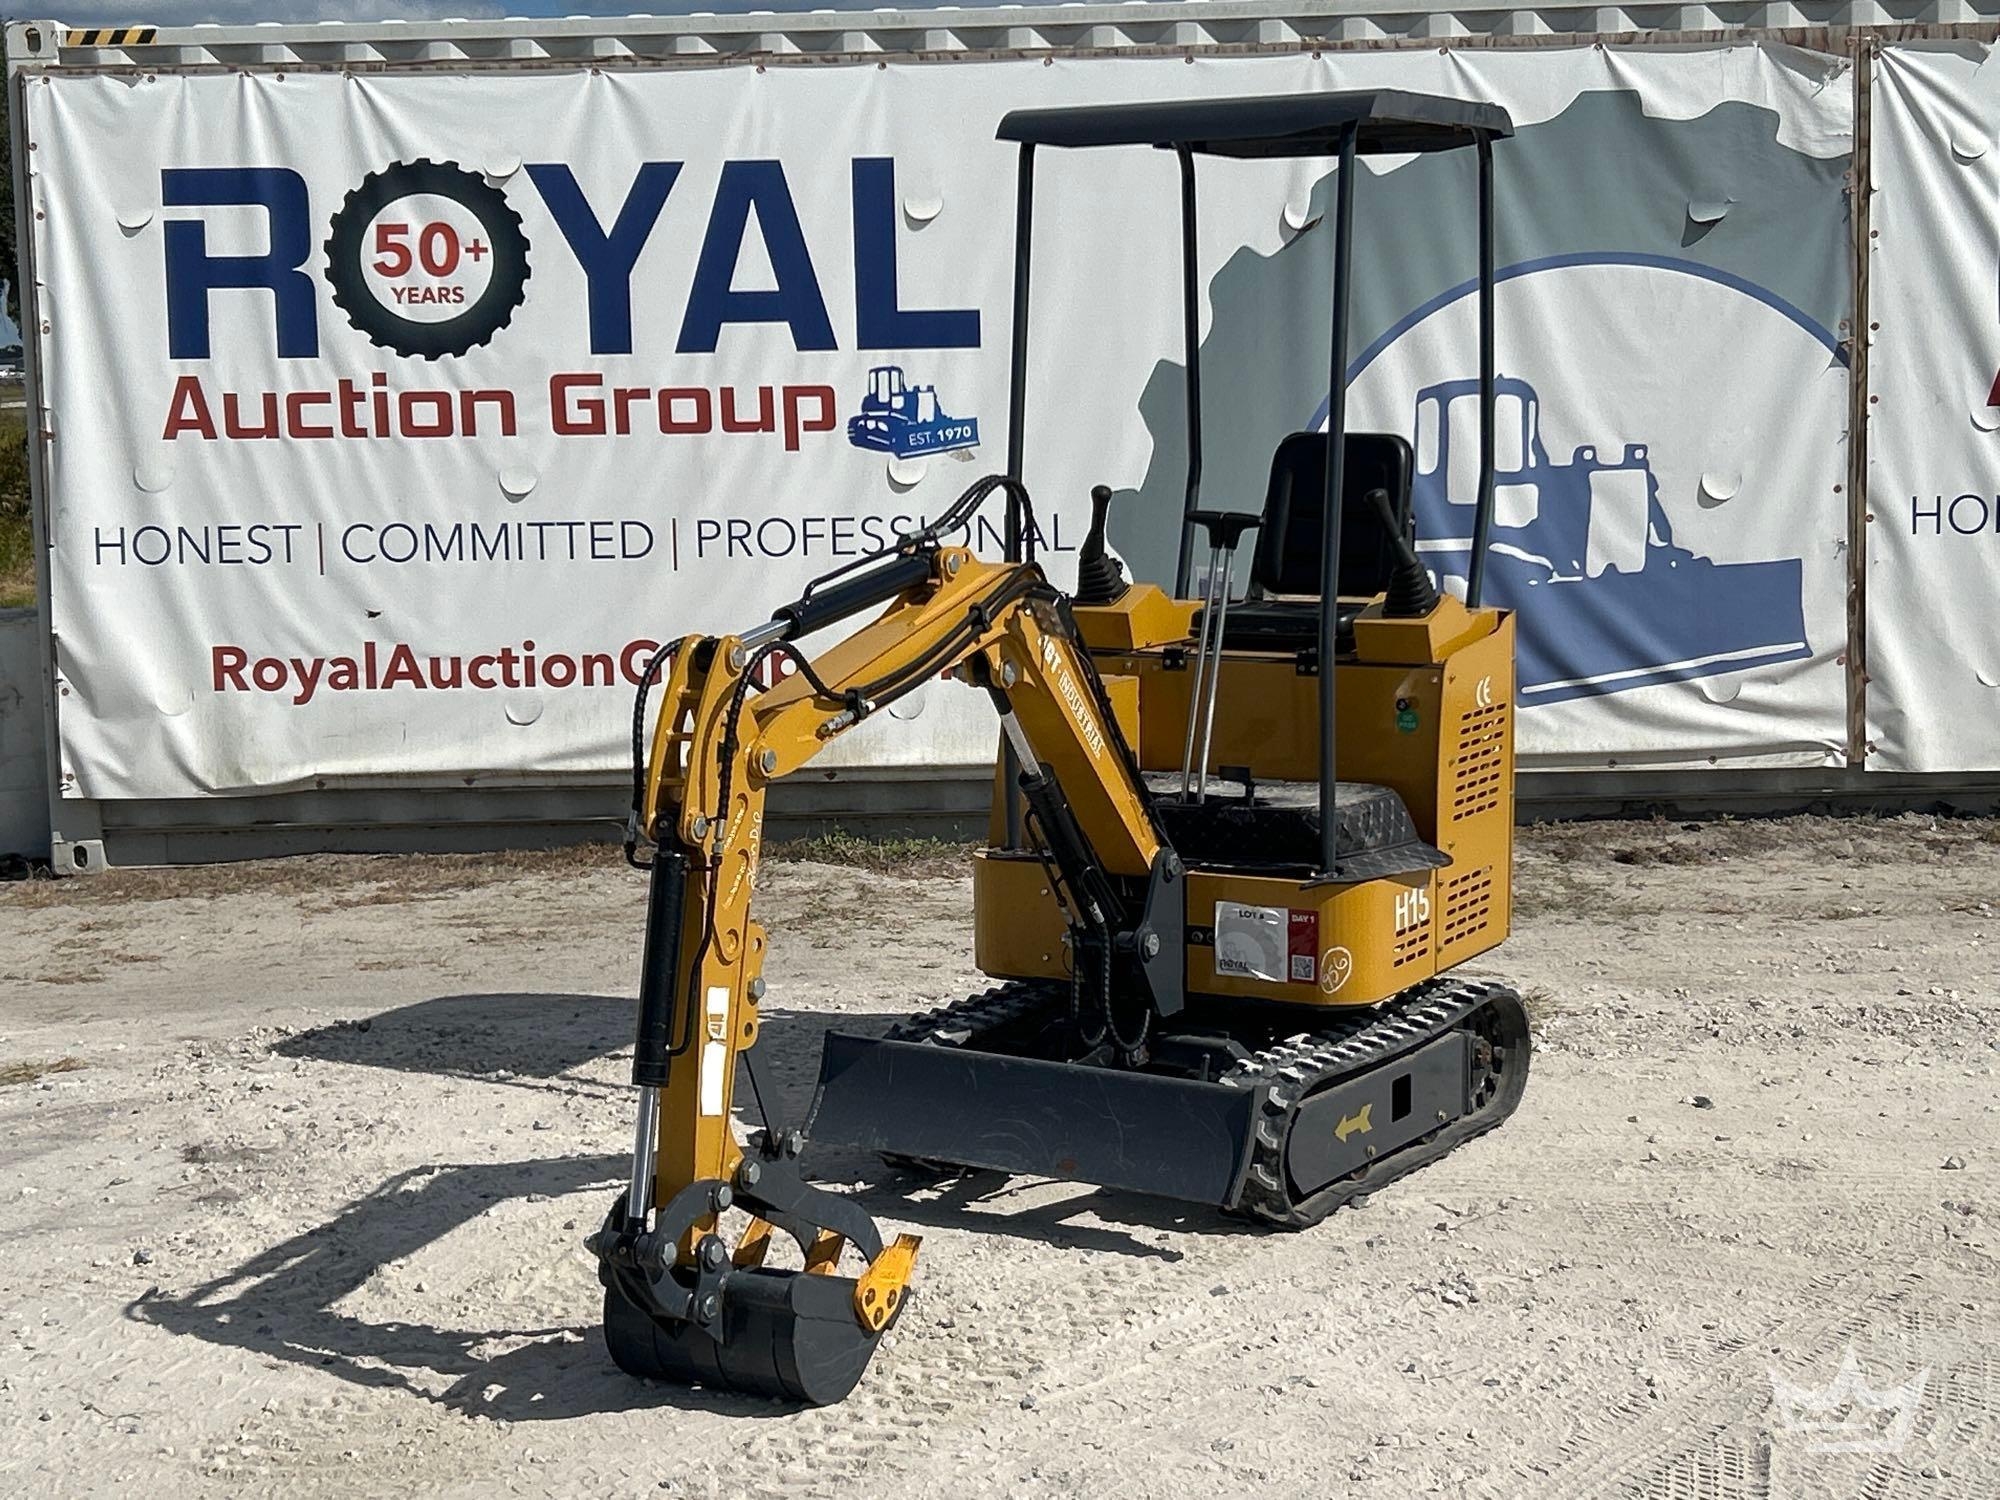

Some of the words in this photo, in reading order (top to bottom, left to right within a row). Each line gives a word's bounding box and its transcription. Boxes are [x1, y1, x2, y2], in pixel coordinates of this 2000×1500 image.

[373, 222, 489, 278] 50+
[390, 286, 465, 305] YEARS
[163, 372, 517, 440] Auction
[550, 372, 837, 451] Group
[908, 431, 935, 446] EST.
[936, 425, 972, 442] 1970
[94, 523, 302, 566] HONEST
[341, 519, 655, 565] COMMITTED
[1058, 671, 1106, 761] INDUSTRIAL
[1291, 914, 1308, 923] DAY
[1394, 887, 1431, 931] H15
[1321, 956, 1349, 990] 956
